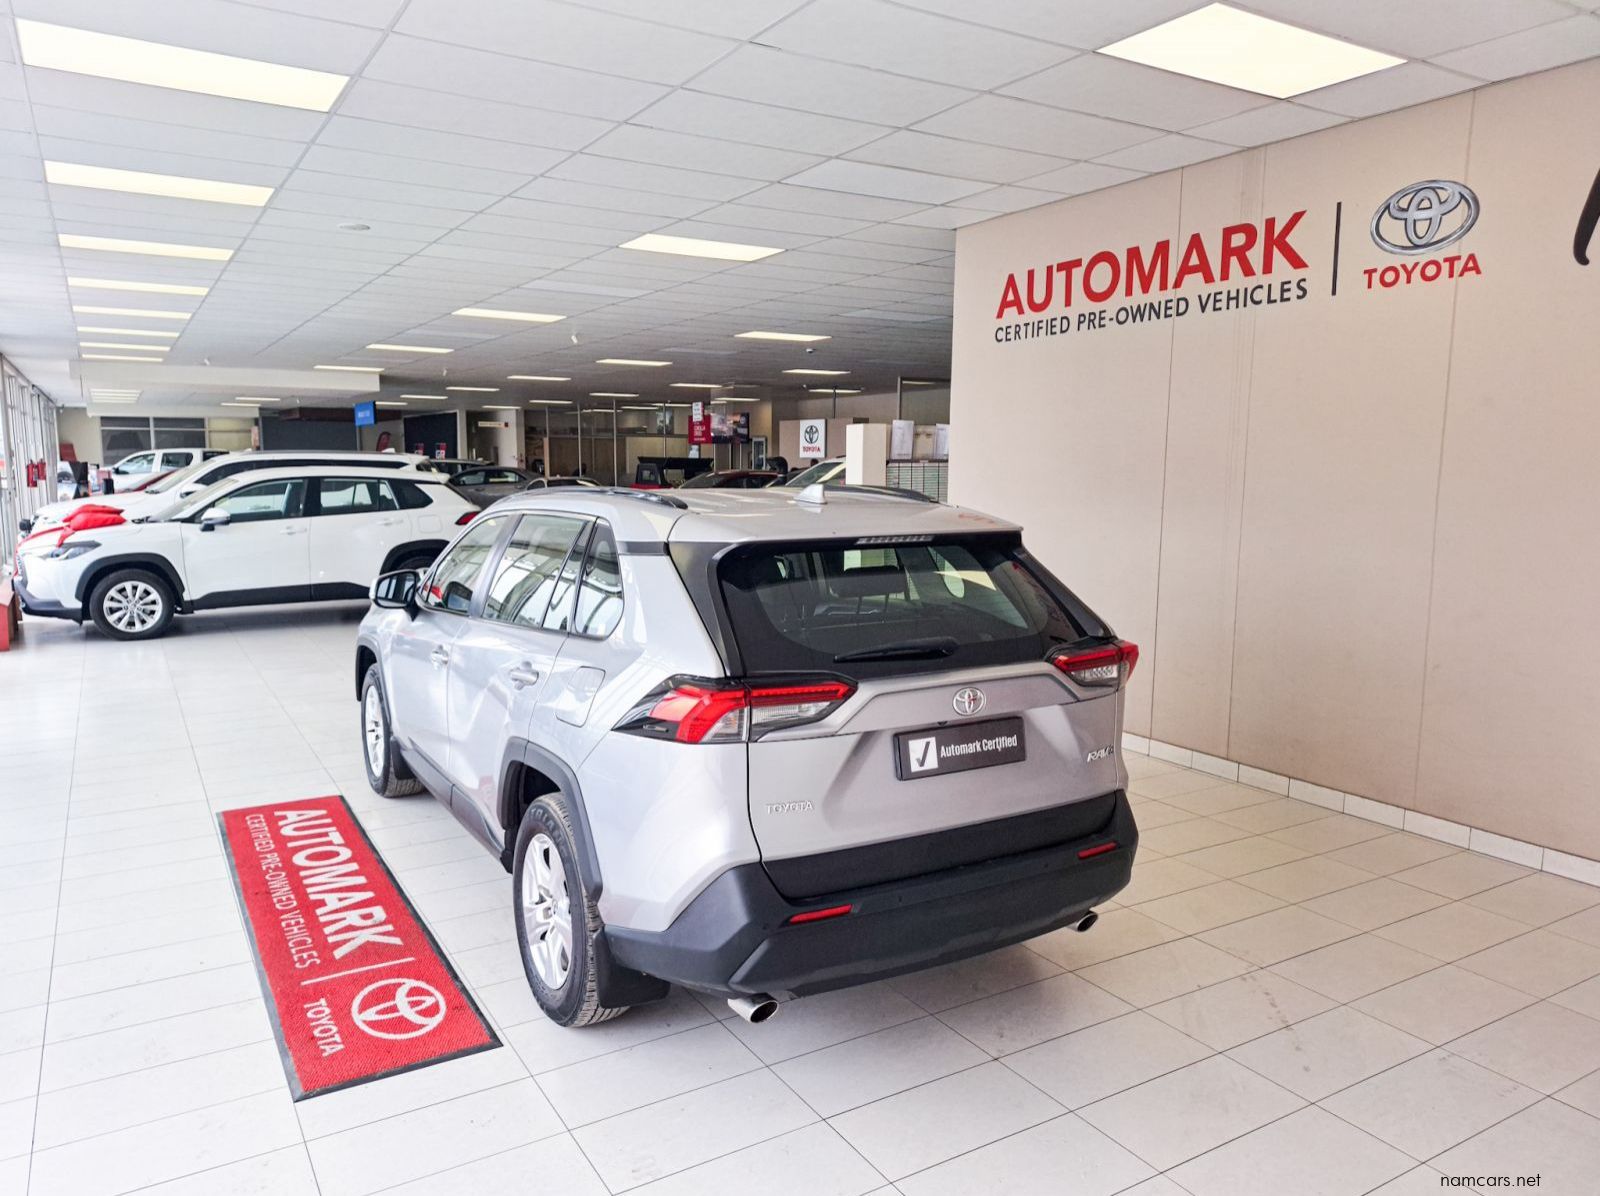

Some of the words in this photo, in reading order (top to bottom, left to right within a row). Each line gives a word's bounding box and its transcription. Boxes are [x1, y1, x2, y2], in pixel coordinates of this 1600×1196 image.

[996, 209, 1309, 319] AUTOMARK
[1363, 253, 1482, 289] TOYOTA
[994, 315, 1071, 343] CERTIFIED
[1077, 296, 1189, 332] PRE-OWNED
[1197, 277, 1308, 314] VEHICLES
[940, 740, 982, 758] Automark
[982, 734, 1018, 752] Certified
[245, 813, 275, 852] CERTIFIED
[765, 800, 813, 815] TOYOTA
[259, 852, 298, 910] PRE-OWNED
[273, 809, 404, 961] AUTOMARK
[279, 910, 321, 969] VEHICLES
[303, 997, 345, 1057] TOYOTA
